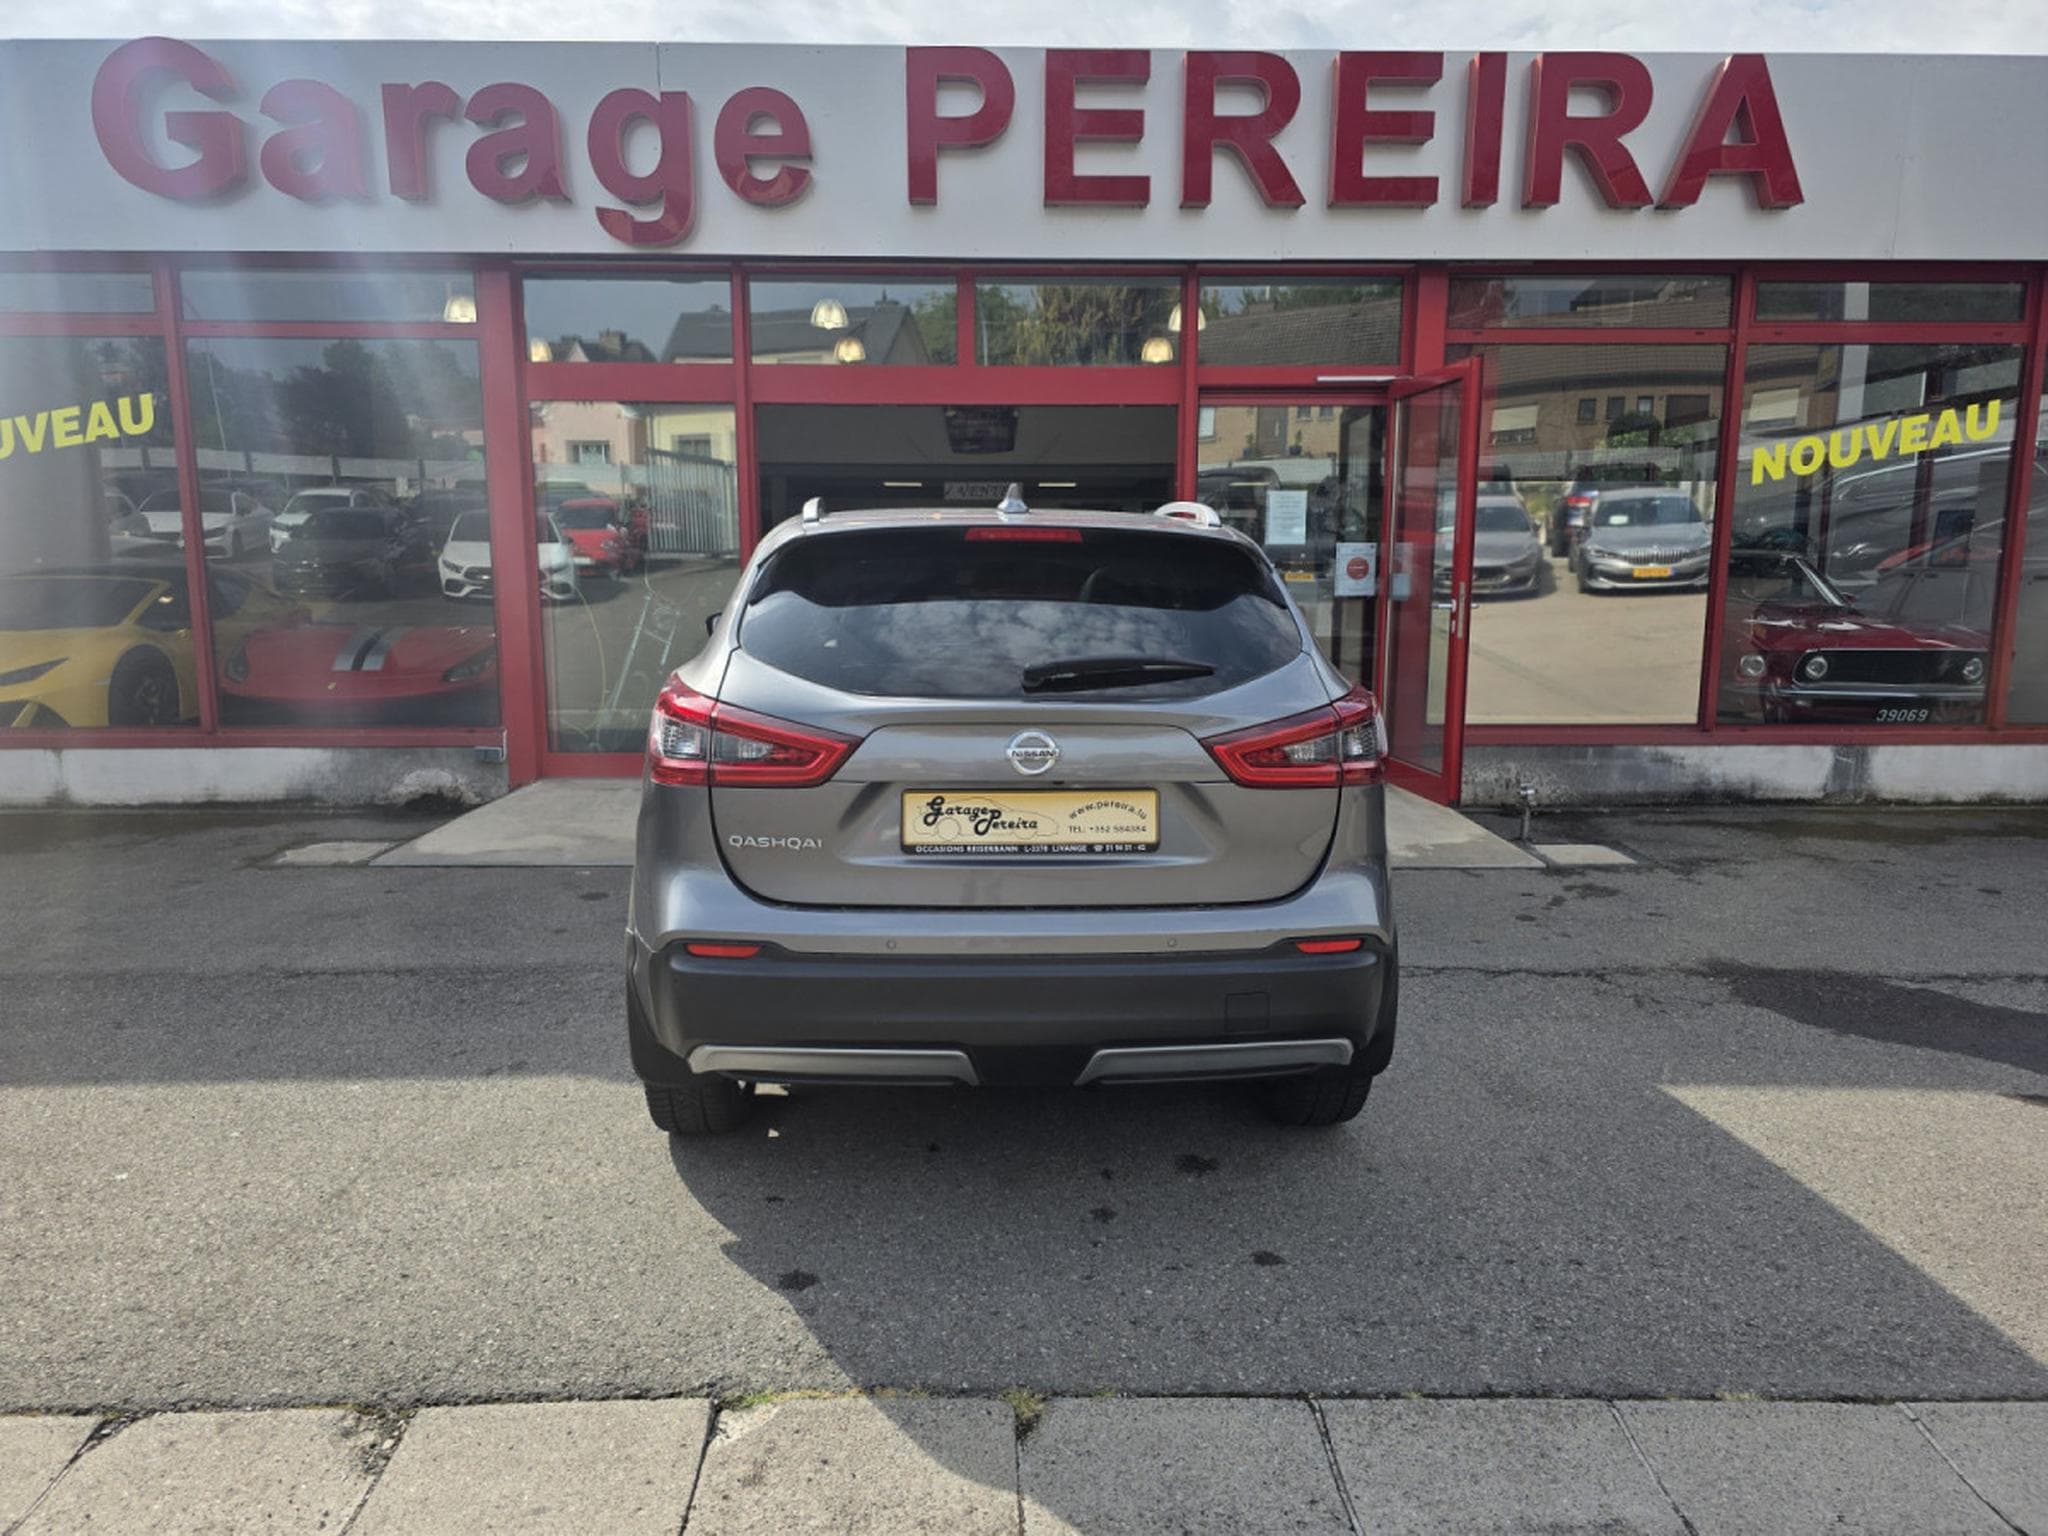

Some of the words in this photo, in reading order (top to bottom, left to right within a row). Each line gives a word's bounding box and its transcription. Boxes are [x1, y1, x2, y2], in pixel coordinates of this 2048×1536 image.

[91, 36, 814, 247] Garage
[905, 47, 1804, 209] PEREIRA
[1751, 399, 2001, 485] NOUVEAU
[923, 795, 989, 827] Garage
[974, 809, 1038, 836] Pereira
[728, 835, 823, 850] QASHQAI
[915, 845, 964, 853] OCCASIONS
